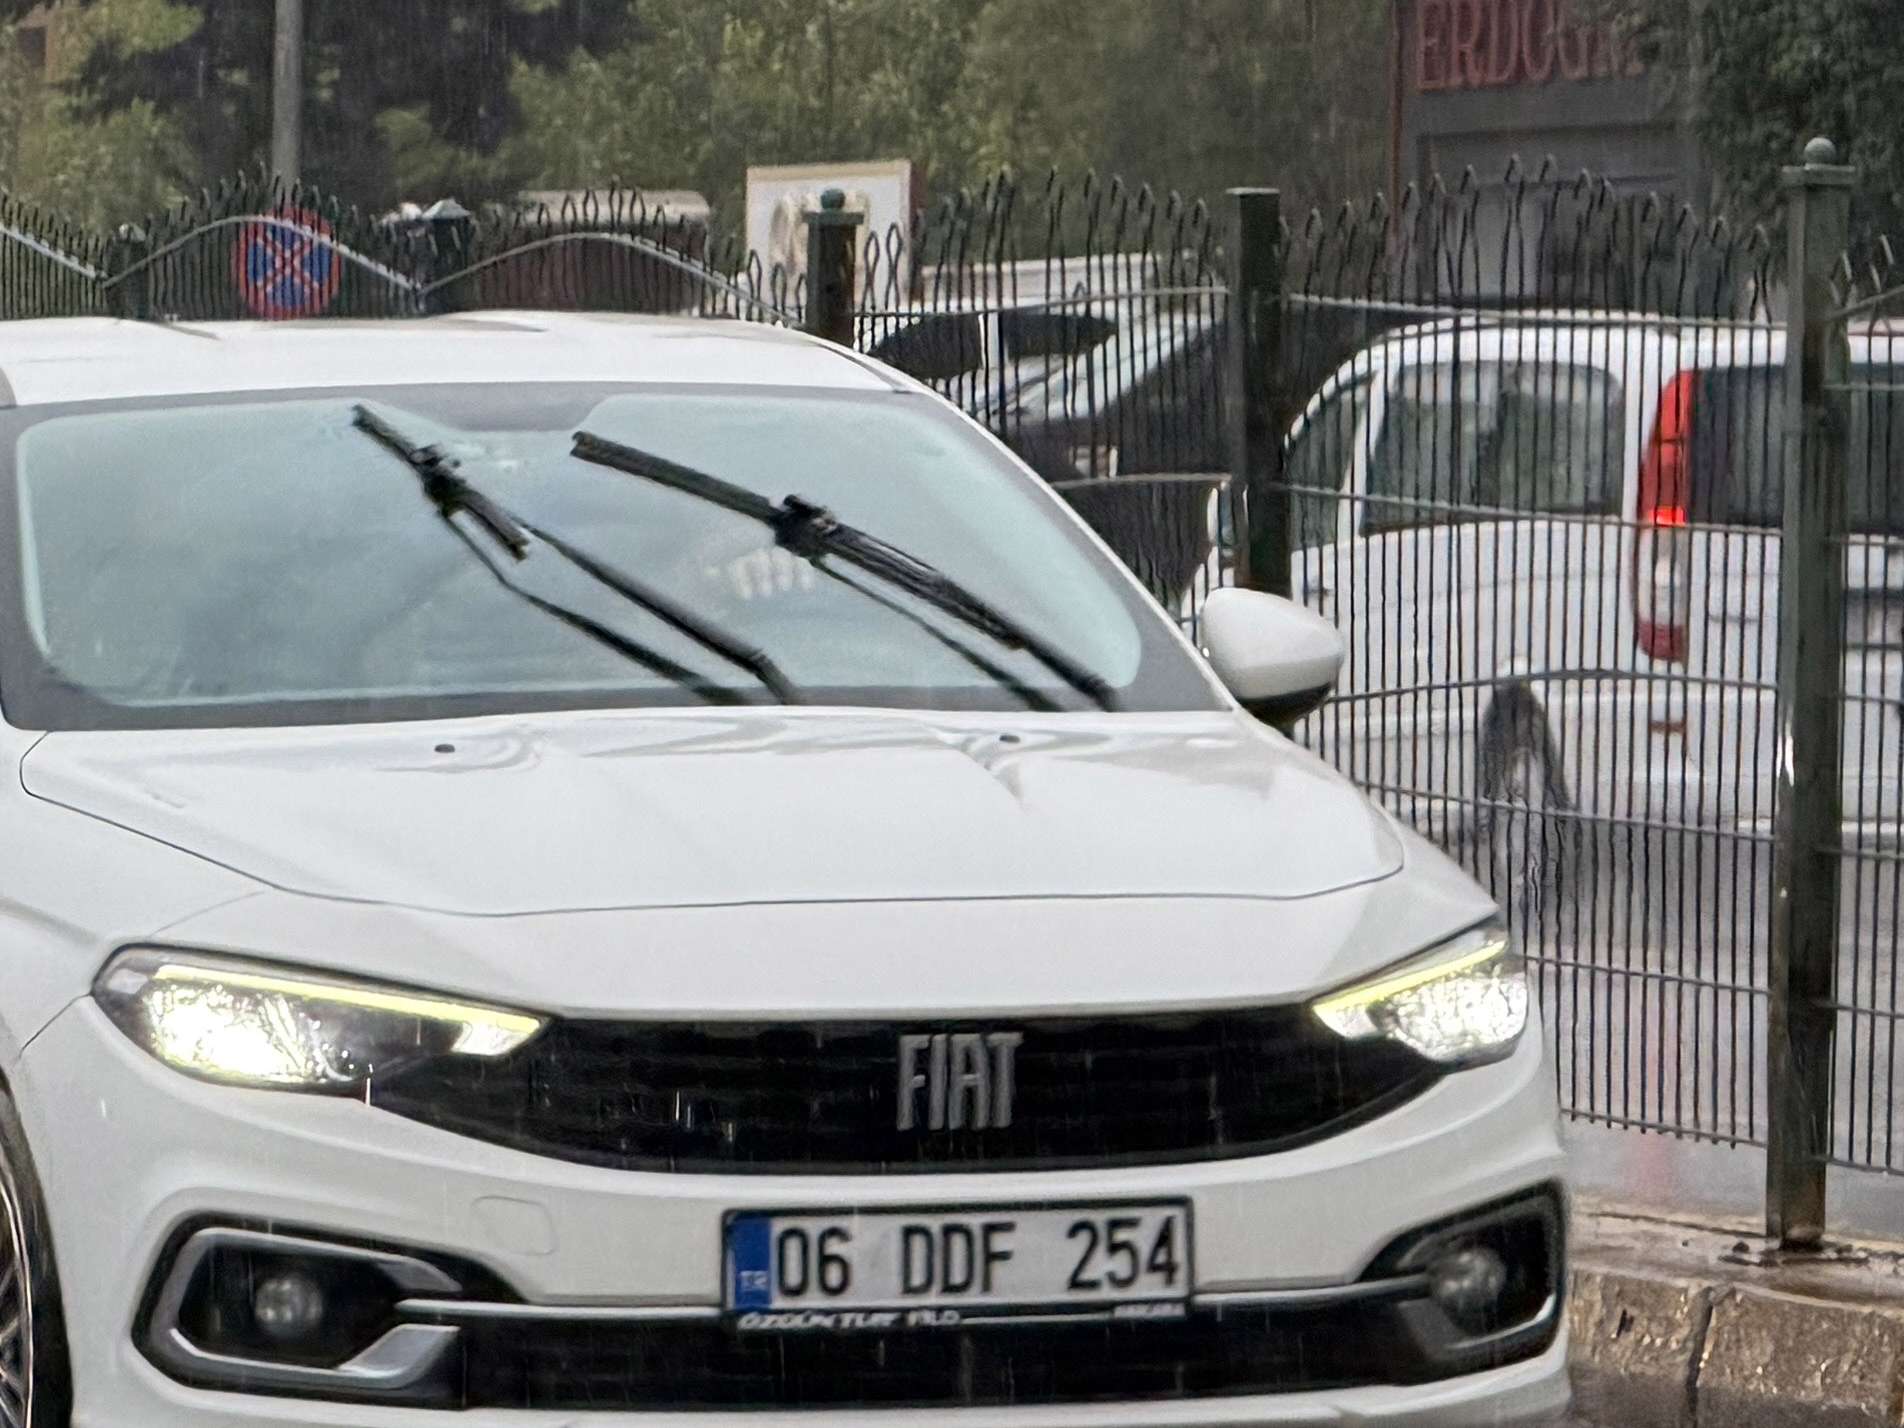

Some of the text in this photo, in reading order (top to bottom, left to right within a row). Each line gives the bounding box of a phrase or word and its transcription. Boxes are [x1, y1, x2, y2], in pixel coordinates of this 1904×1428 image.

[896, 1032, 1024, 1131] FIAT
[777, 1216, 1179, 1297] 06 DDF 254
